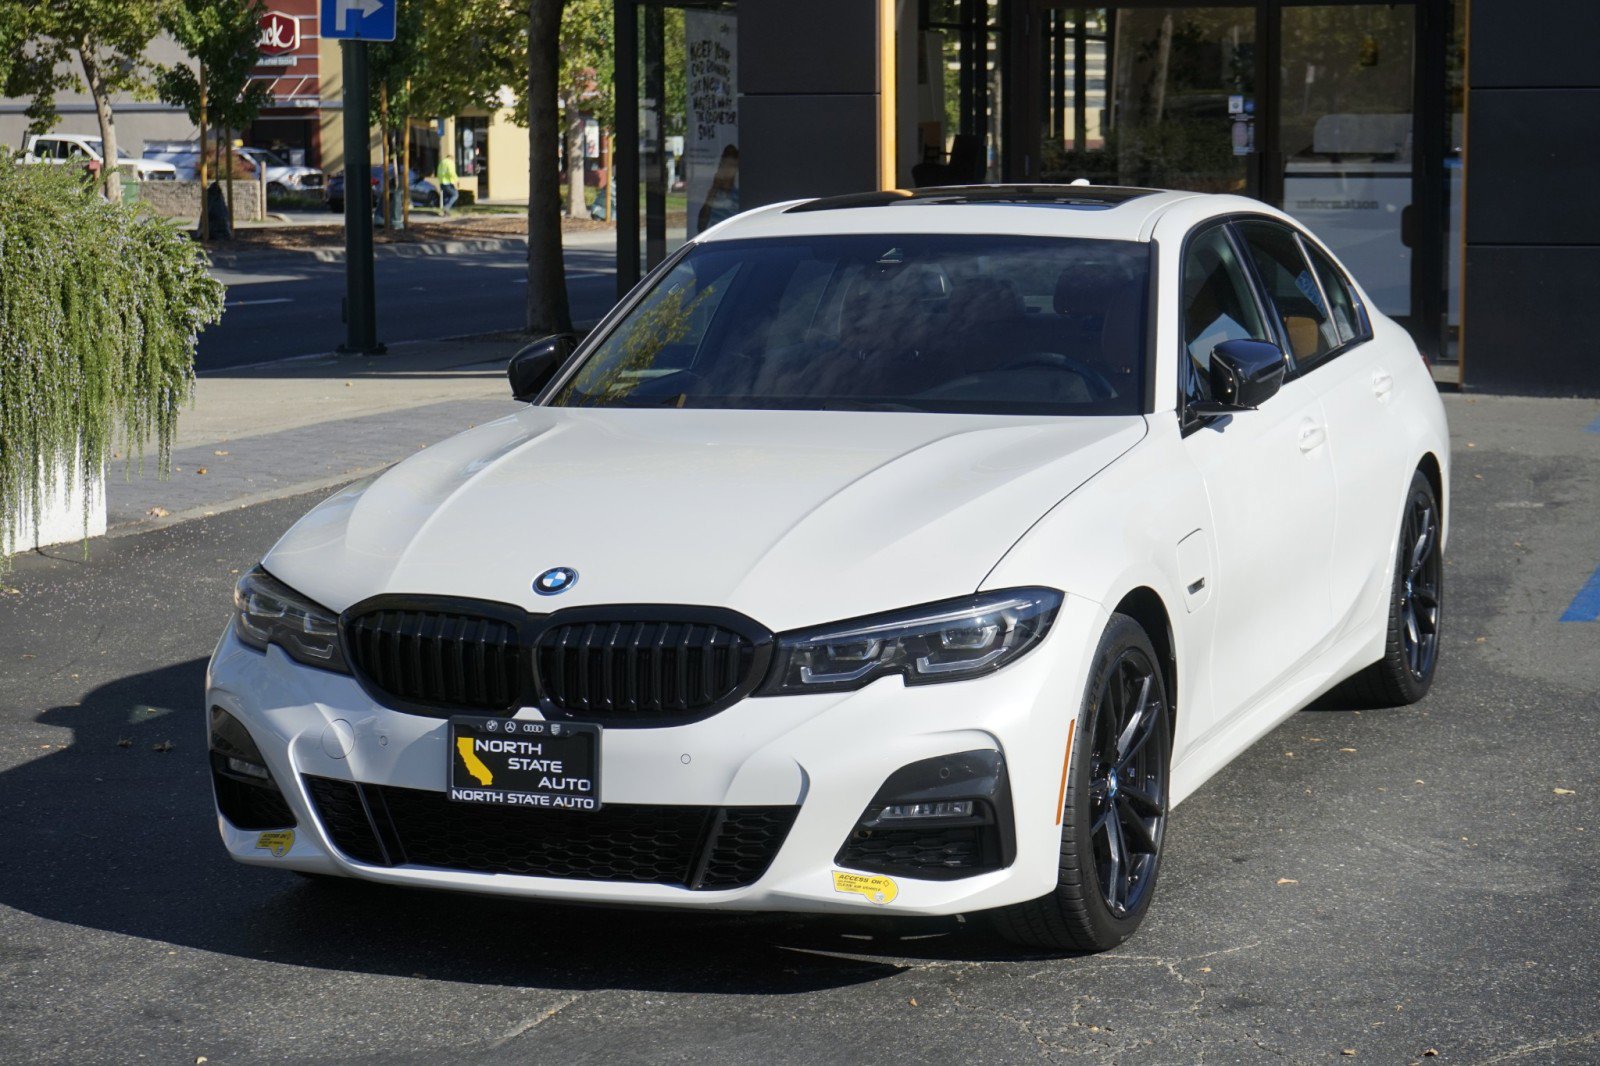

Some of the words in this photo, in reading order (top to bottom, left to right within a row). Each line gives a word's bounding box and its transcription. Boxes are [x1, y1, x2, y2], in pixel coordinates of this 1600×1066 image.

[475, 740, 542, 755] NORTH
[508, 758, 562, 773] STATE
[538, 777, 591, 791] AUTO
[452, 790, 503, 803] NORTH
[507, 793, 549, 806] STATE
[553, 797, 594, 809] AUTO
[839, 875, 869, 883] ACCESS
